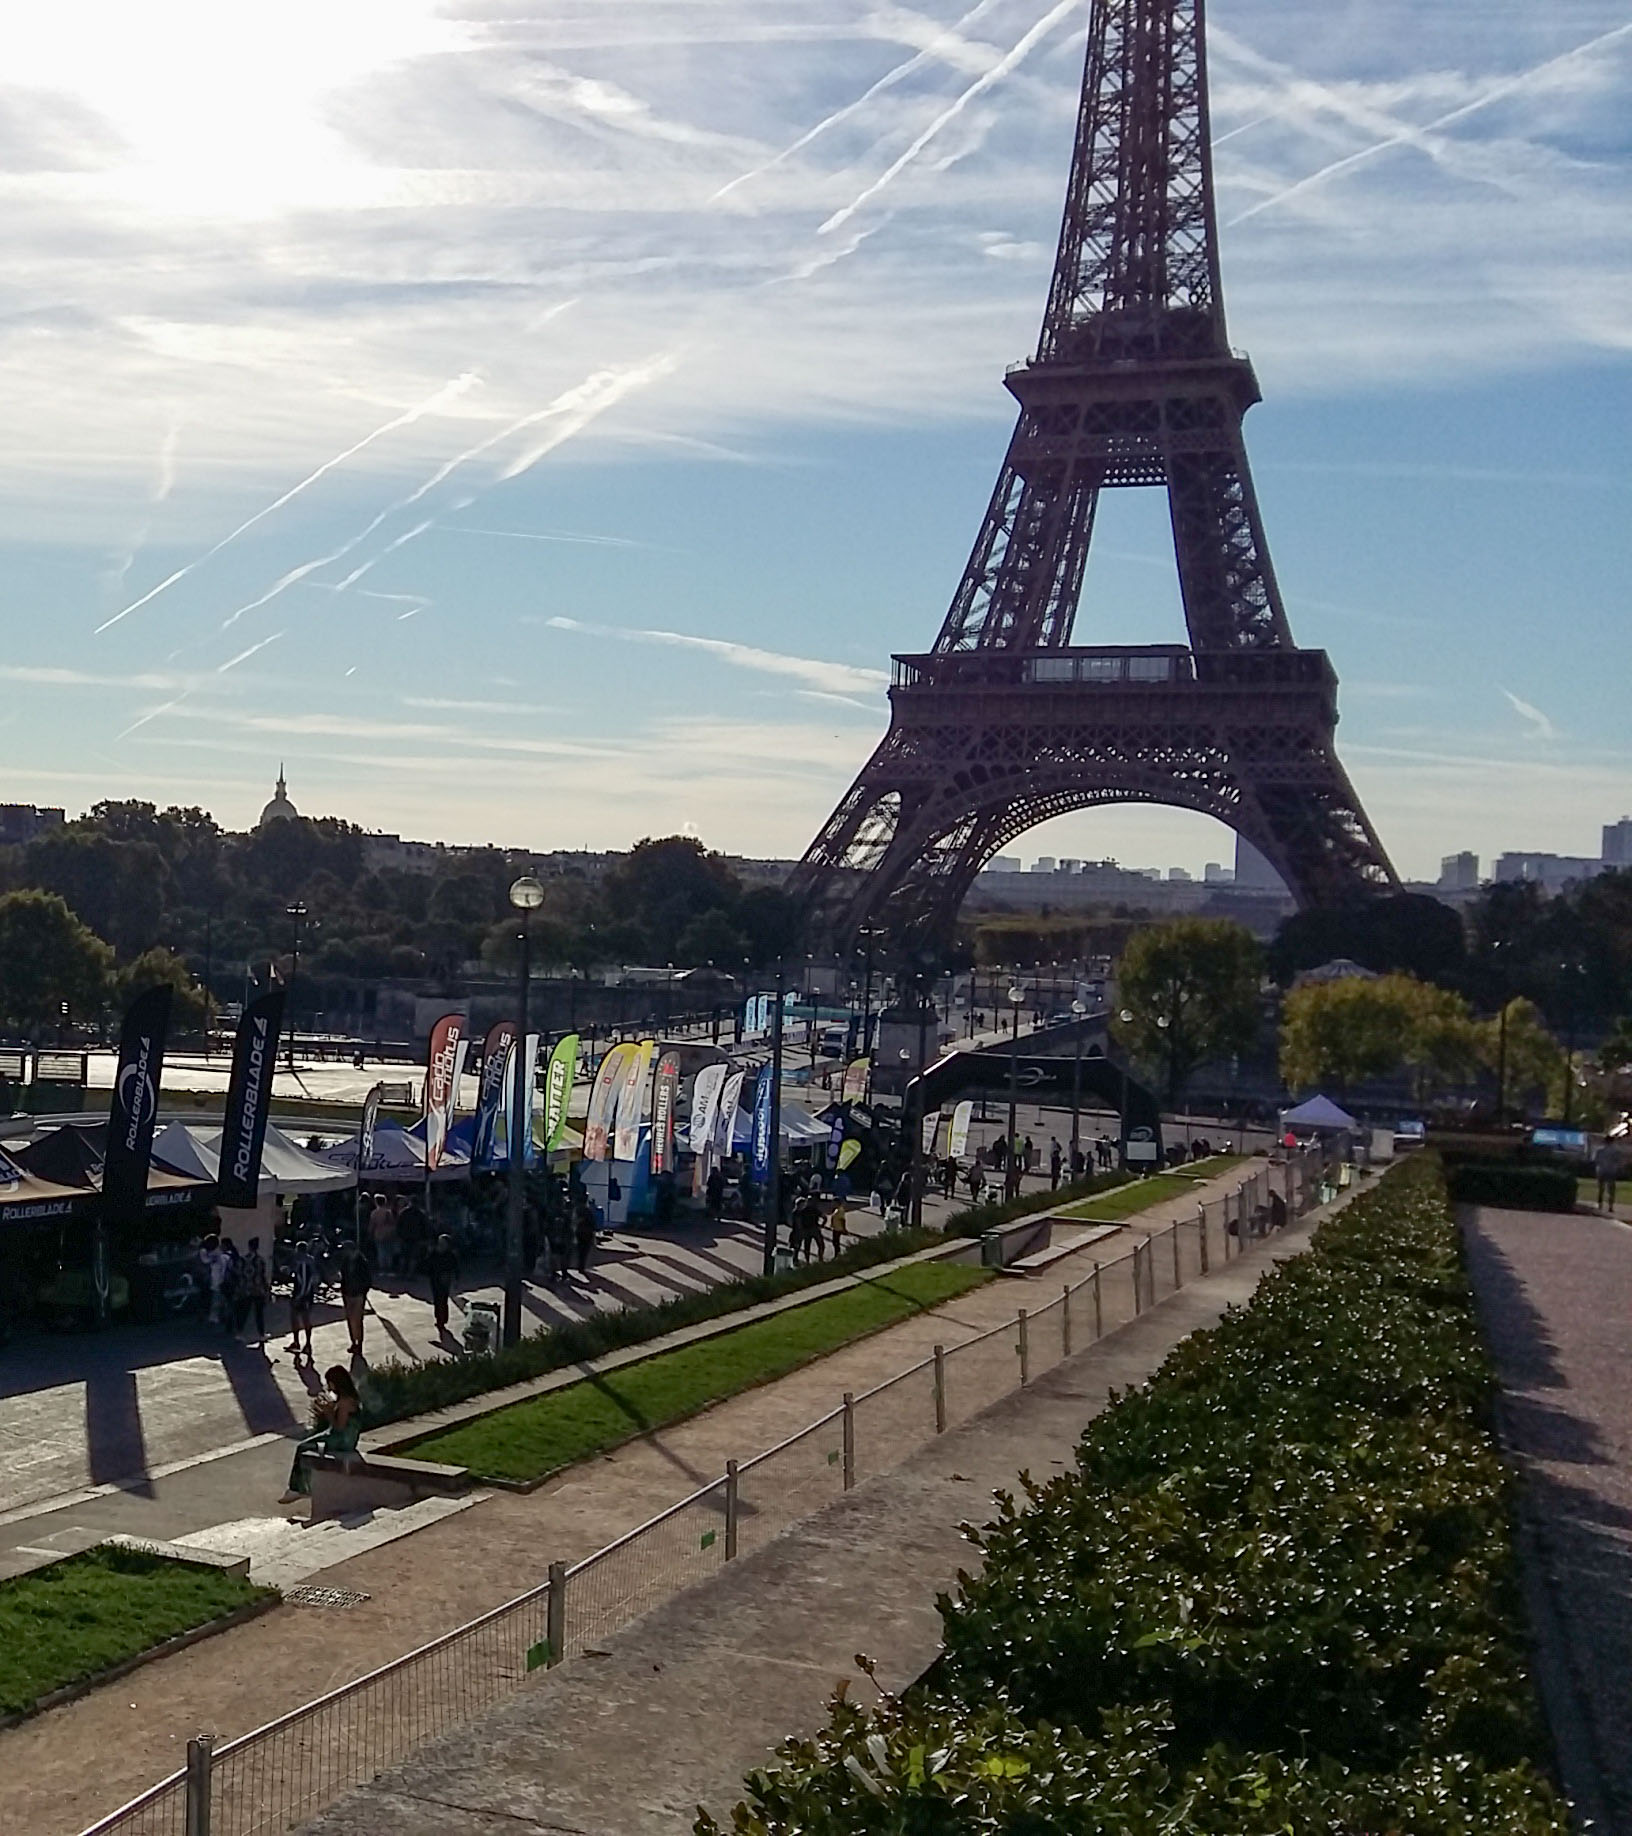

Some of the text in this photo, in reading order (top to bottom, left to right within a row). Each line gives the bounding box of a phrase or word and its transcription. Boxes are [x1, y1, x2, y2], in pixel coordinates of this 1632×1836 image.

[443, 1026, 460, 1086] motus
[125, 1049, 149, 1151] ROLLERBLADE
[233, 1036, 265, 1182] ROLLERBLADE
[545, 1058, 566, 1137] MATTER
[657, 1085, 669, 1122] ROLLERS
[655, 1122, 666, 1154] HEURES
